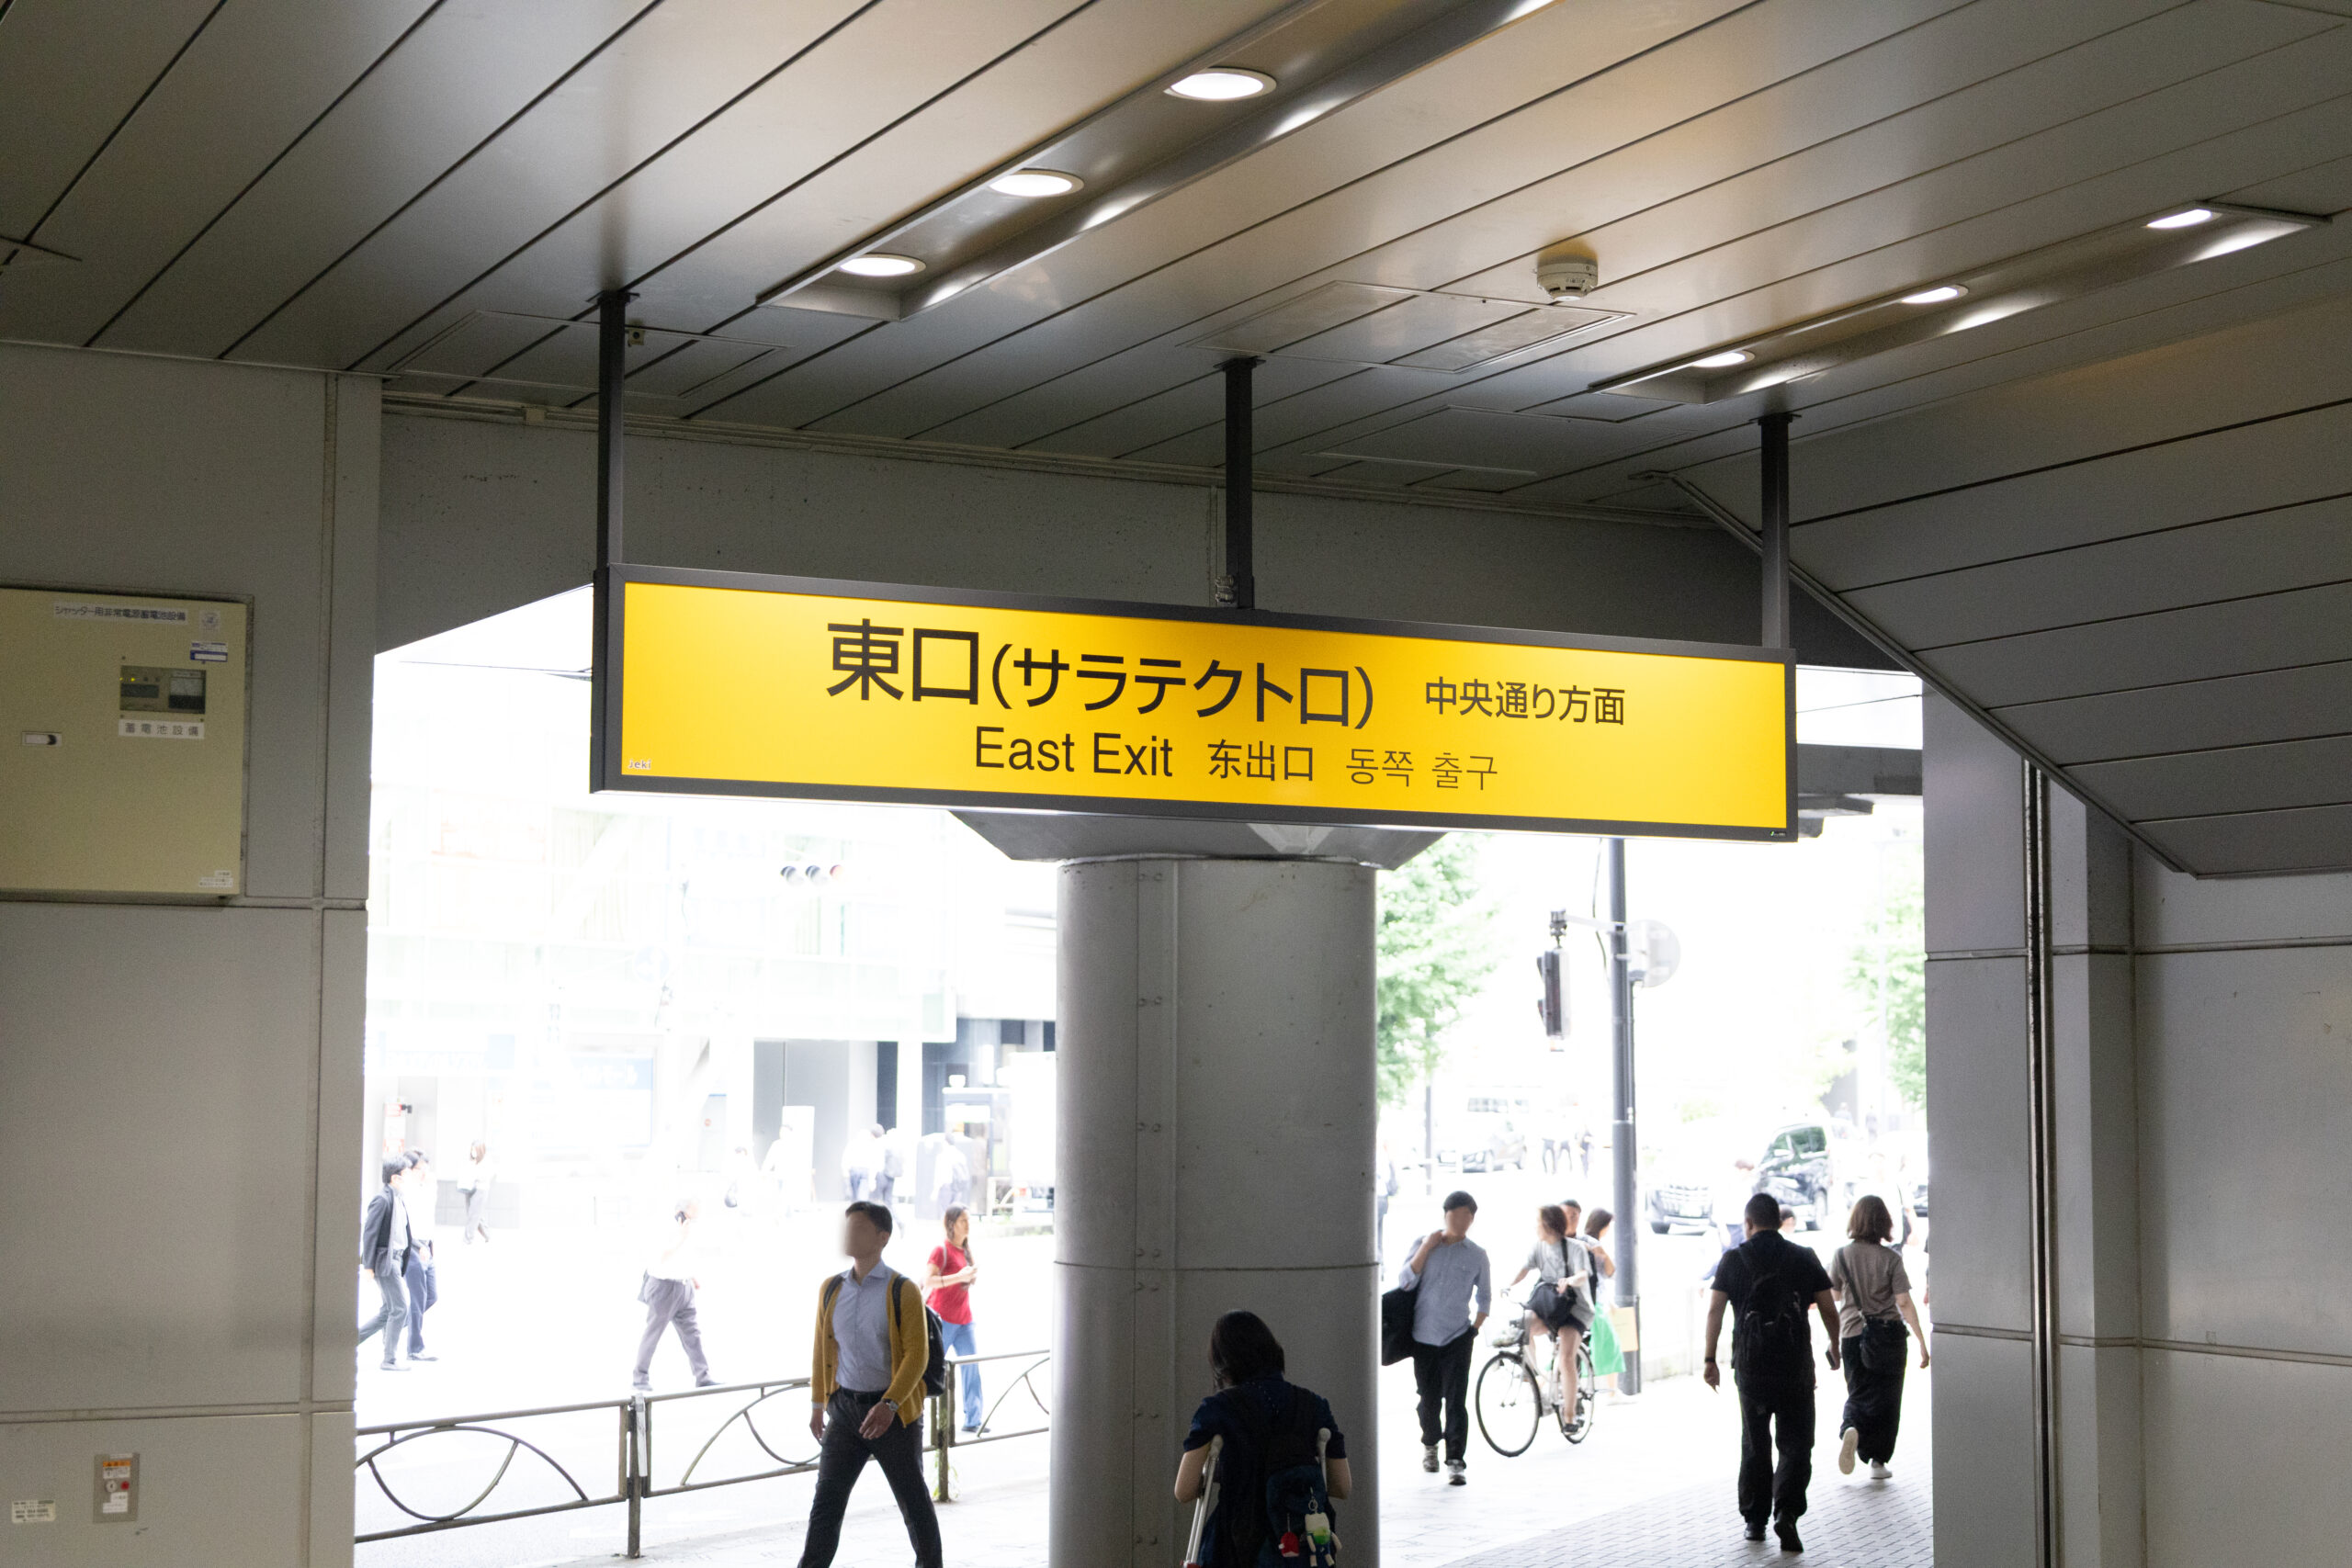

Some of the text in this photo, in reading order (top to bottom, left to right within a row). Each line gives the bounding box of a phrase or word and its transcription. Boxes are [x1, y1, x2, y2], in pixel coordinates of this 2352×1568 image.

[1426, 676, 1625, 726] 中央通り方面
[125, 722, 198, 736] 蓄電池設備
[976, 726, 1173, 777] East Exit
[1207, 739, 1313, 782] 东出口
[1346, 748, 1498, 791] 동쪽 출구
